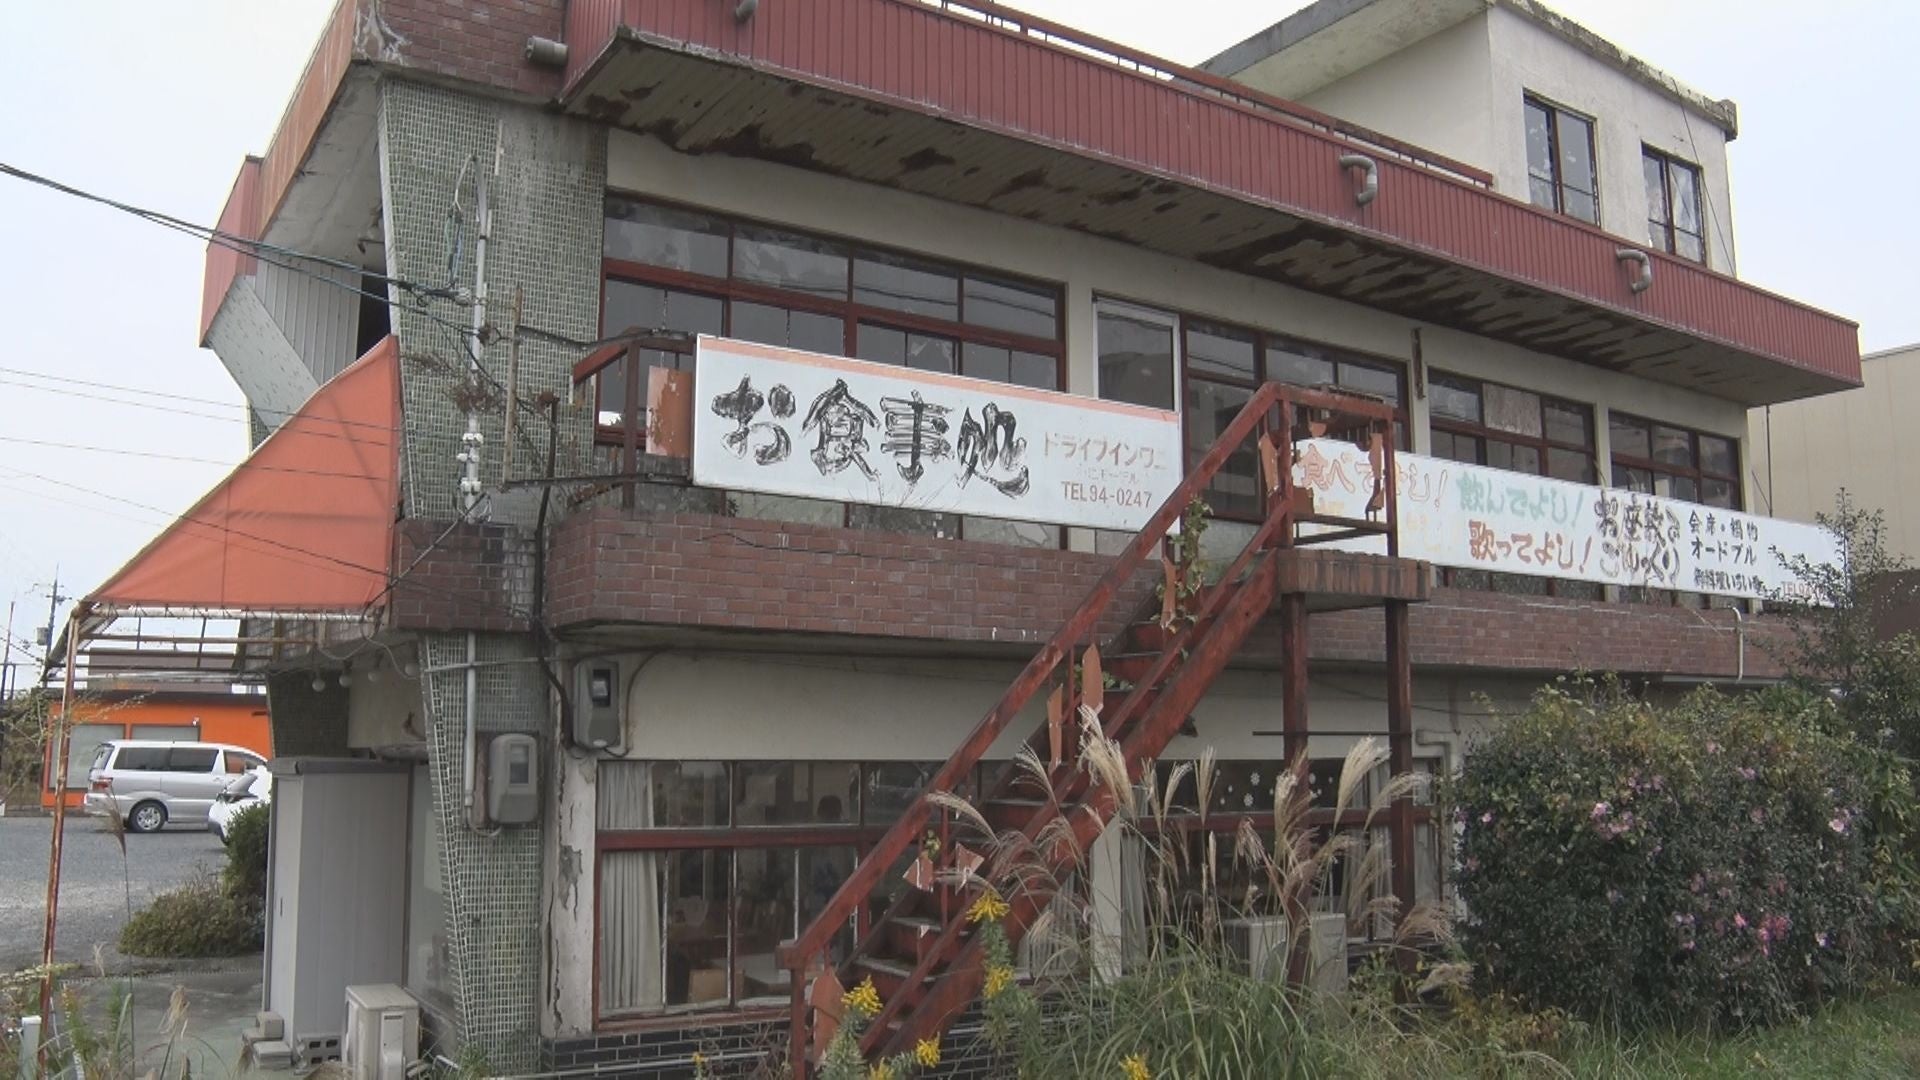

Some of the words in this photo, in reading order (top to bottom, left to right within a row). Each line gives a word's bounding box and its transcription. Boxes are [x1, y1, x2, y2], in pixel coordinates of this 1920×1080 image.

[712, 374, 1029, 498] お食事処
[1691, 536, 1757, 565] オードブル
